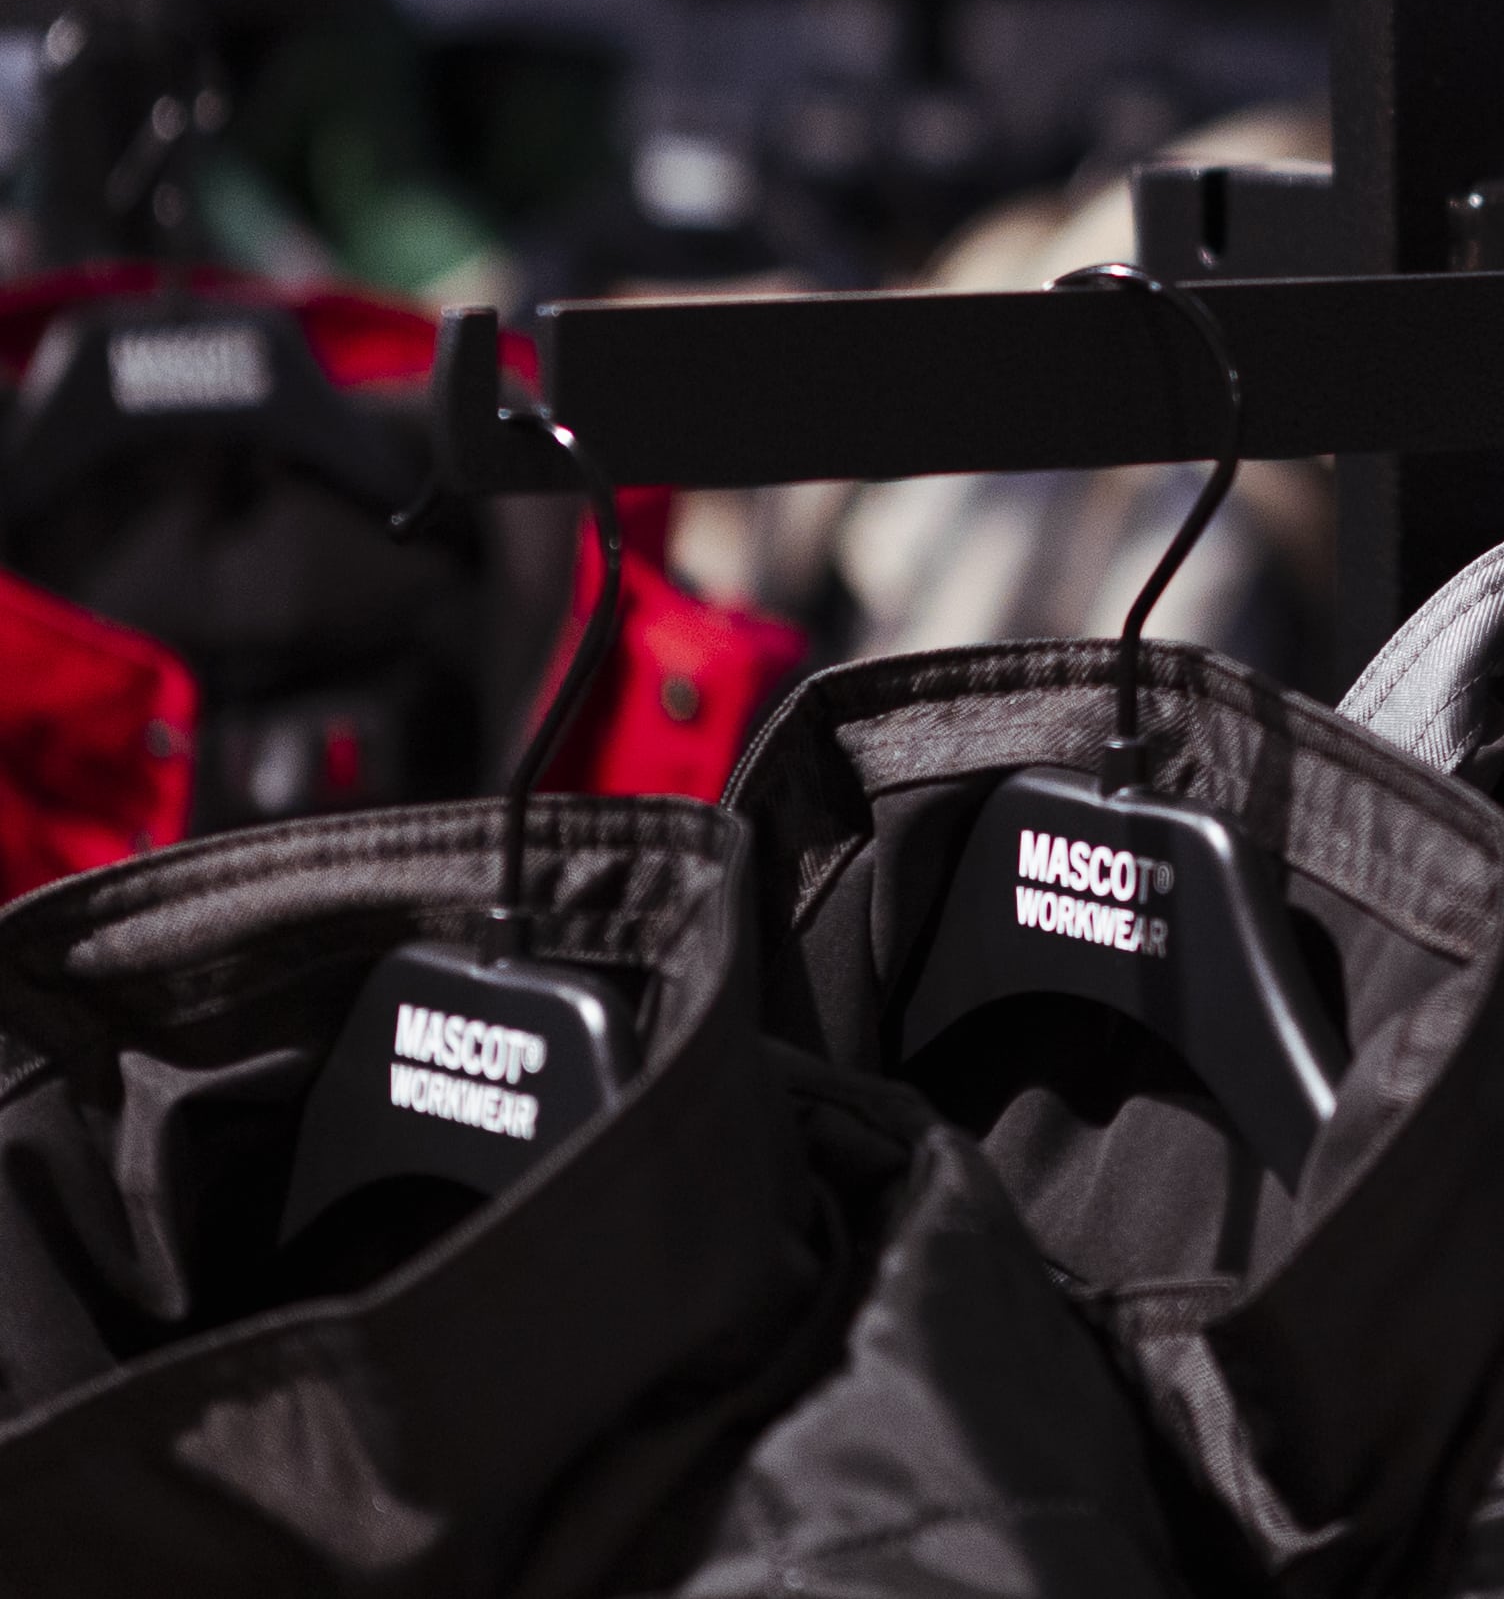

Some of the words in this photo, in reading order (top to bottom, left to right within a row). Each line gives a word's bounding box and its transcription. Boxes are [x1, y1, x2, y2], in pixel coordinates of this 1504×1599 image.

[1018, 828, 1175, 905] MASCOT®
[1014, 884, 1169, 959] WORKWEAR
[389, 1060, 540, 1141] WORKWEAR
